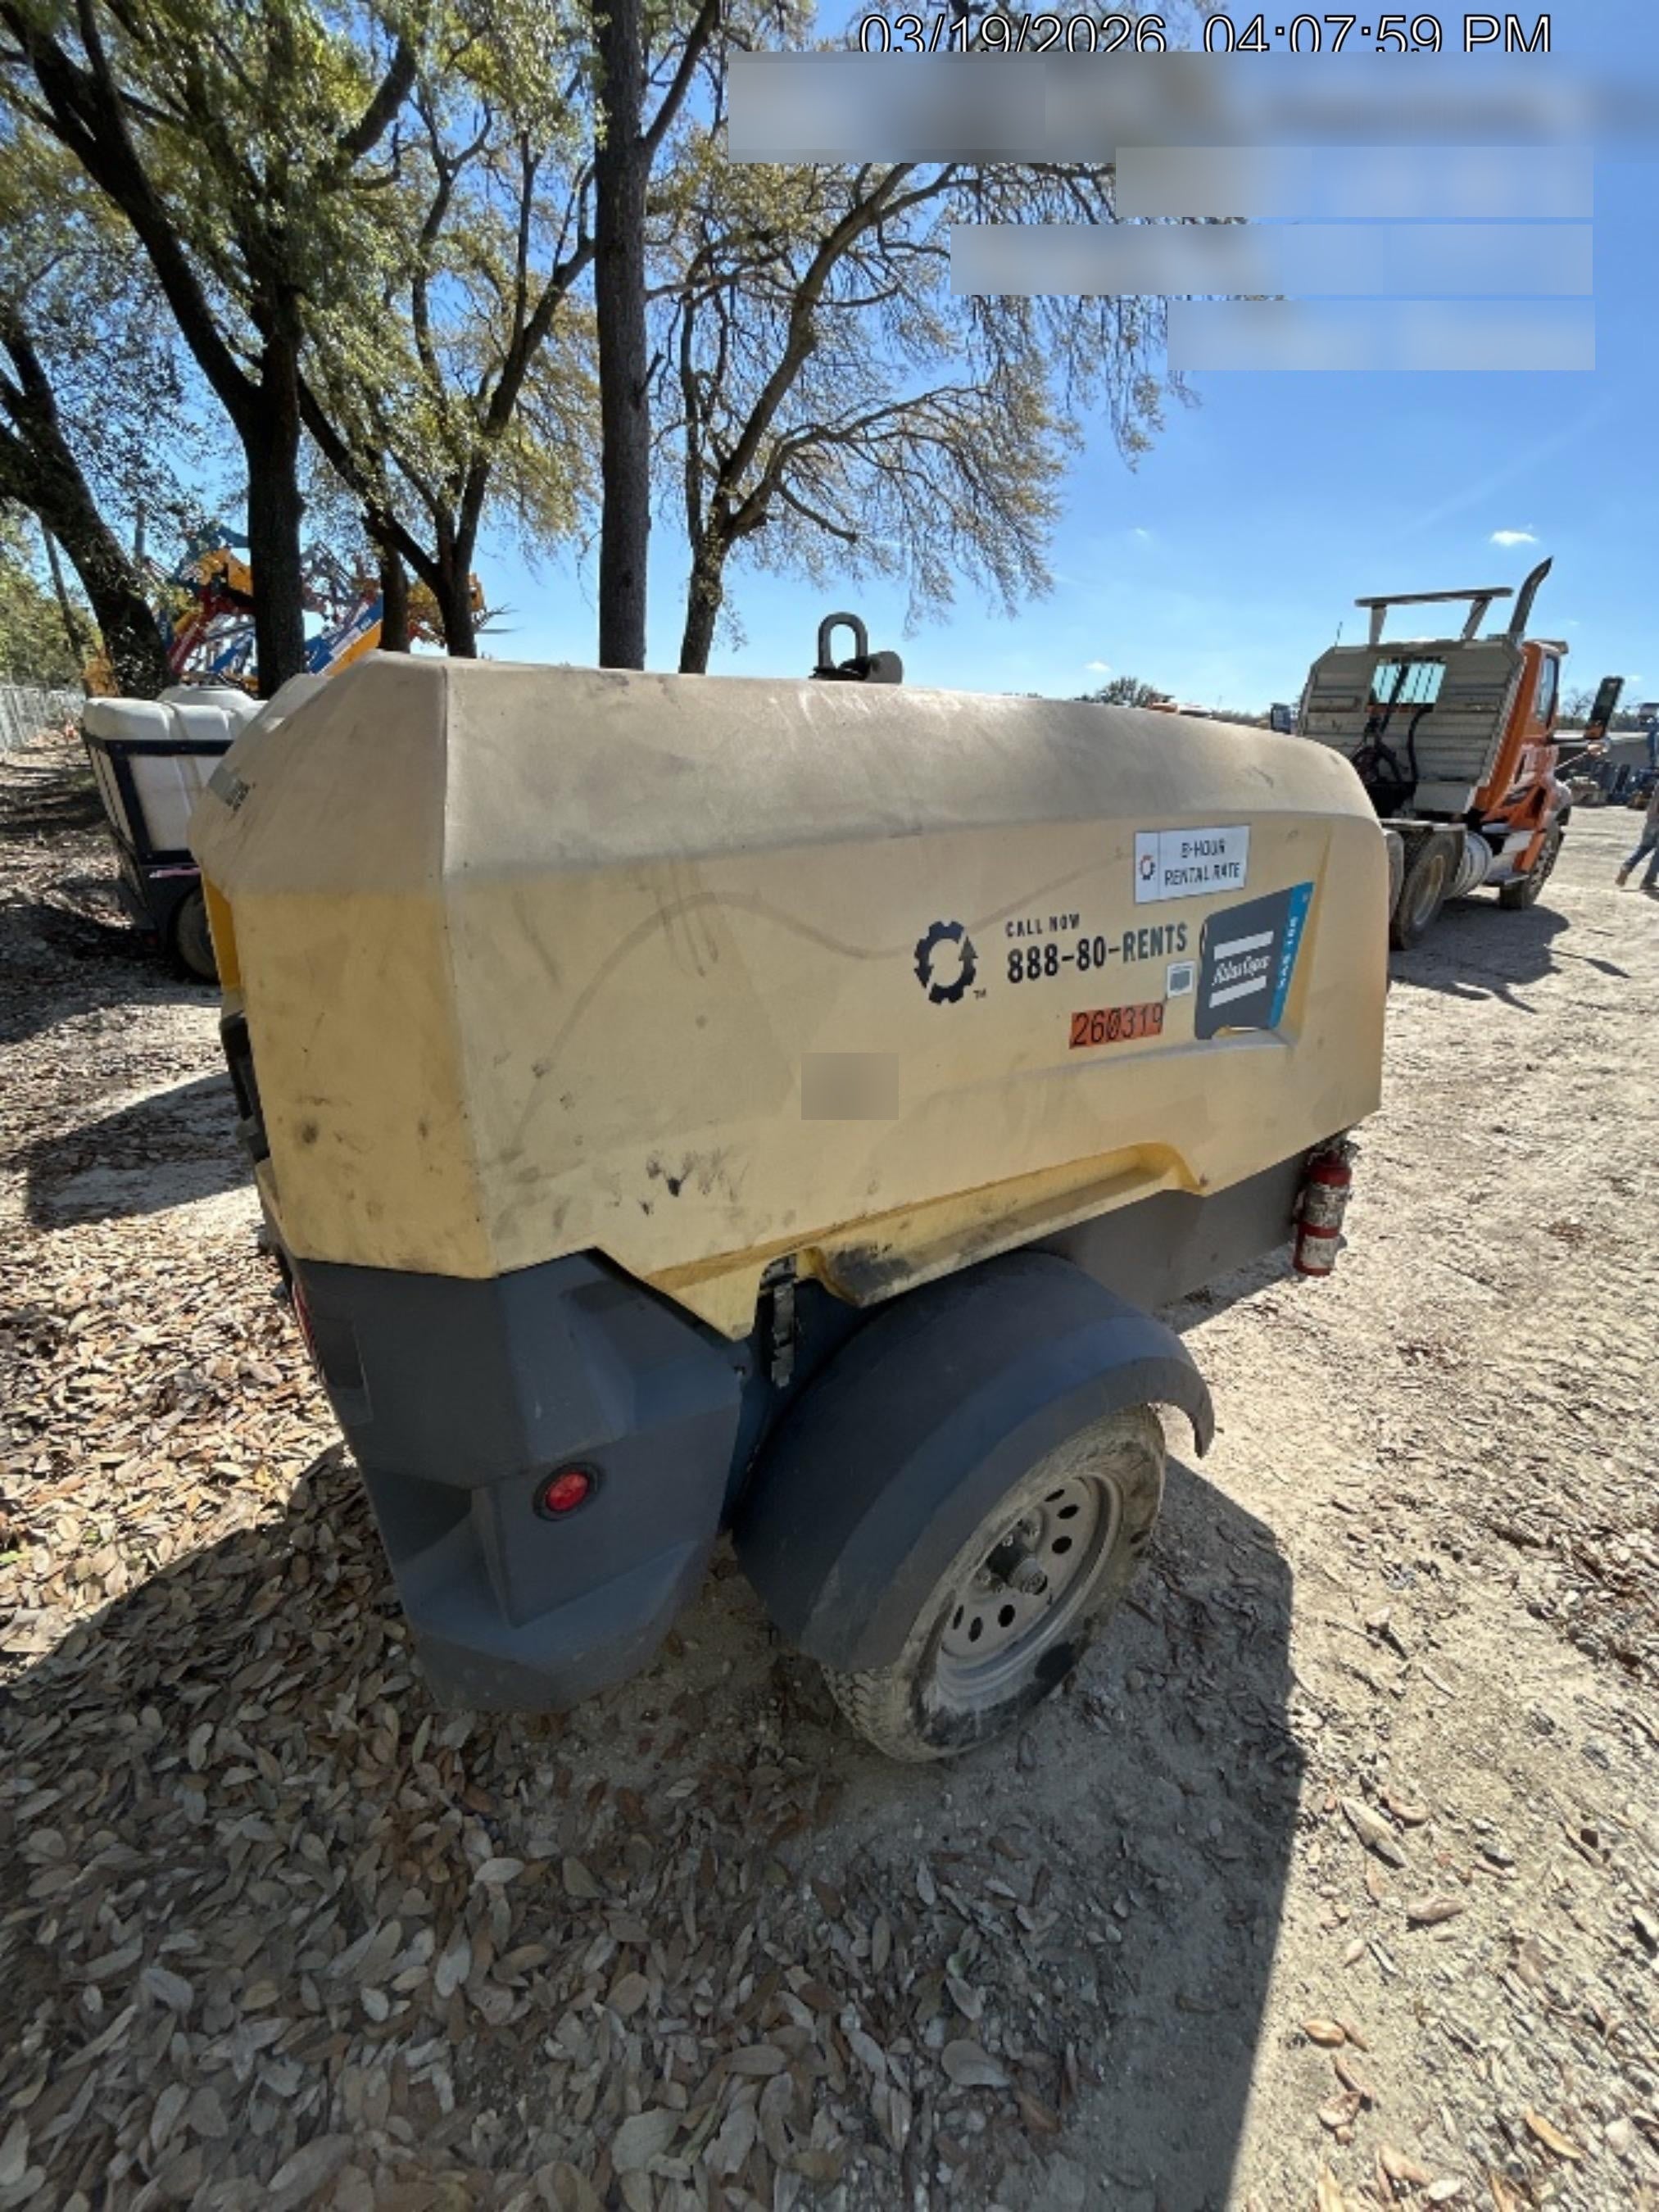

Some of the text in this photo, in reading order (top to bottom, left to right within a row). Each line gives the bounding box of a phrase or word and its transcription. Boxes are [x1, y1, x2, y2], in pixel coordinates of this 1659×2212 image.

[1164, 862, 1240, 886] RENTAL RATE
[1005, 913, 1080, 937] CALL NOW
[1007, 922, 1188, 984] 888-80-RENTS
[1072, 1002, 1163, 1045] 260319
